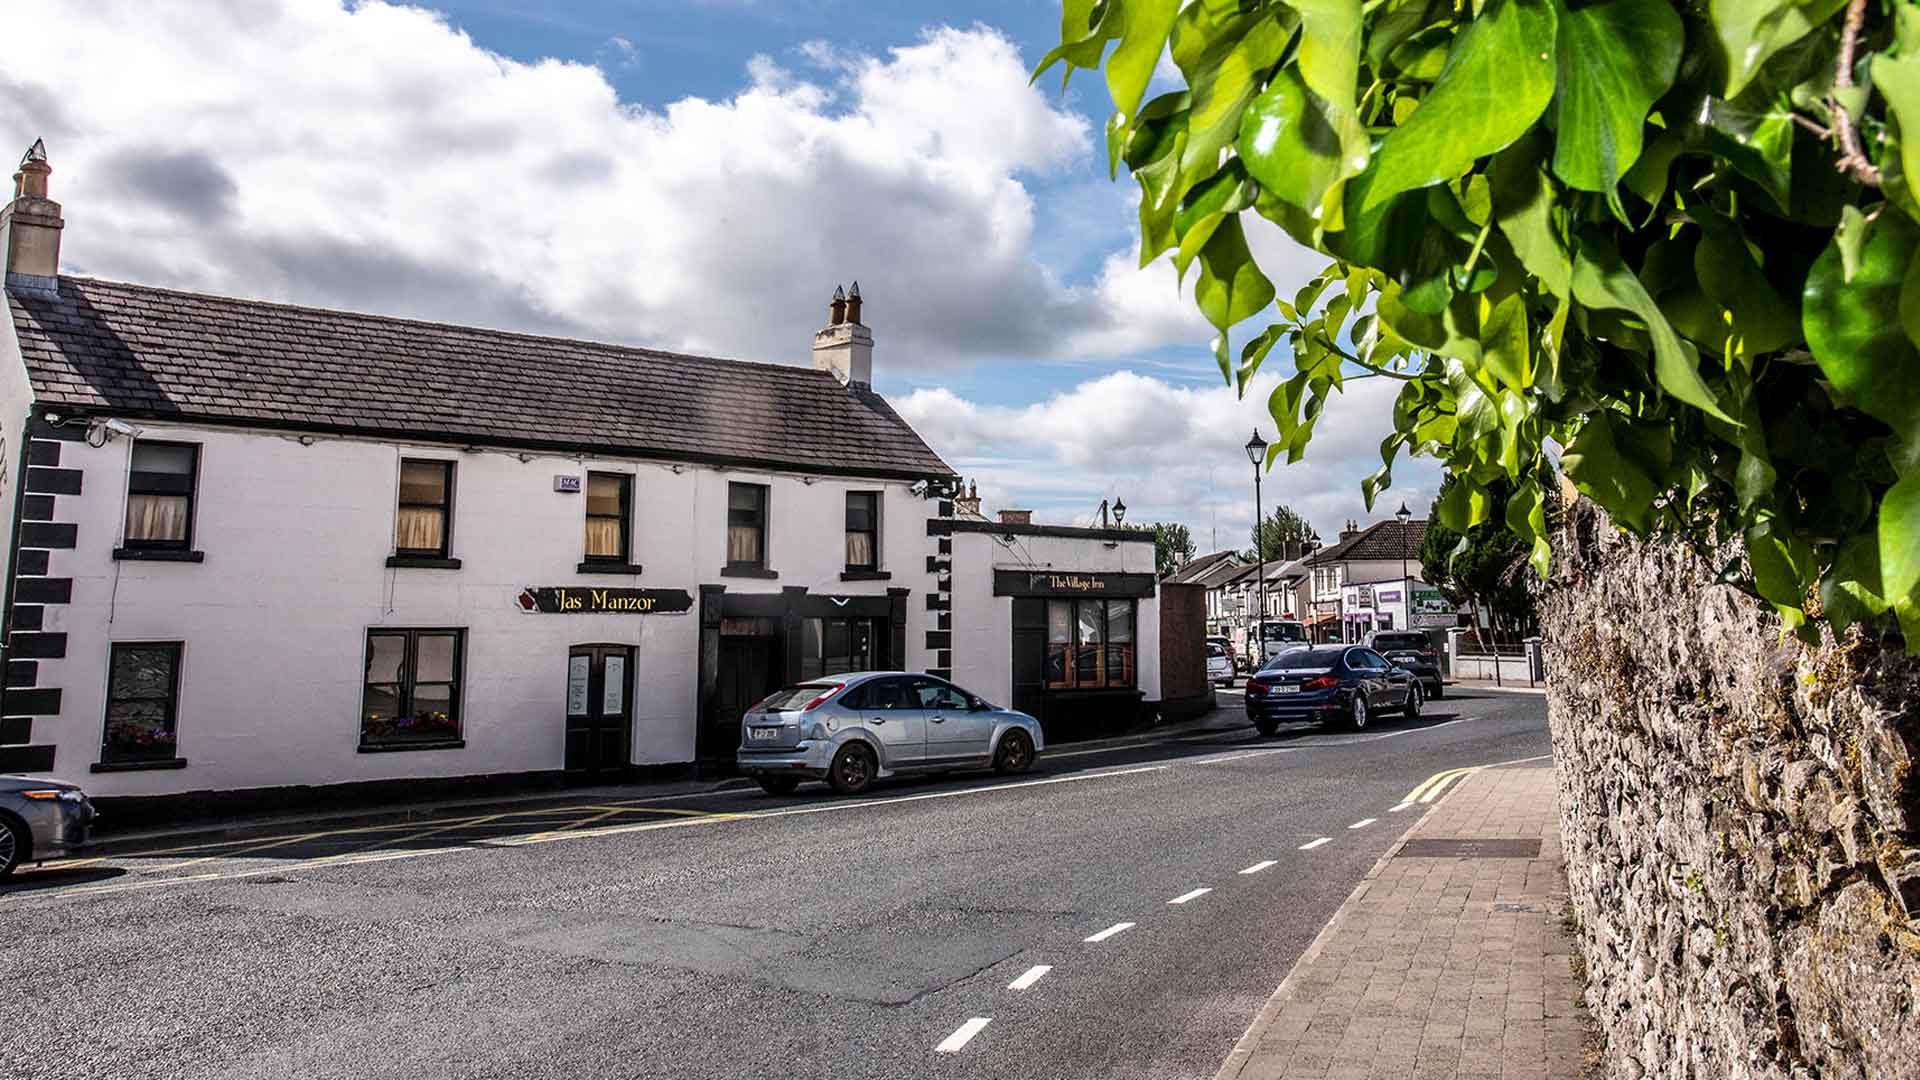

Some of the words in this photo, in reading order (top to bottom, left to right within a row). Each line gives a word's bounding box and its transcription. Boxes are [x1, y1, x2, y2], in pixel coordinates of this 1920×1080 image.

[1049, 575, 1066, 588] The
[1066, 575, 1091, 592] Village
[1092, 576, 1105, 589] Inn
[560, 589, 582, 612] Jas
[591, 589, 656, 611] Manzor
